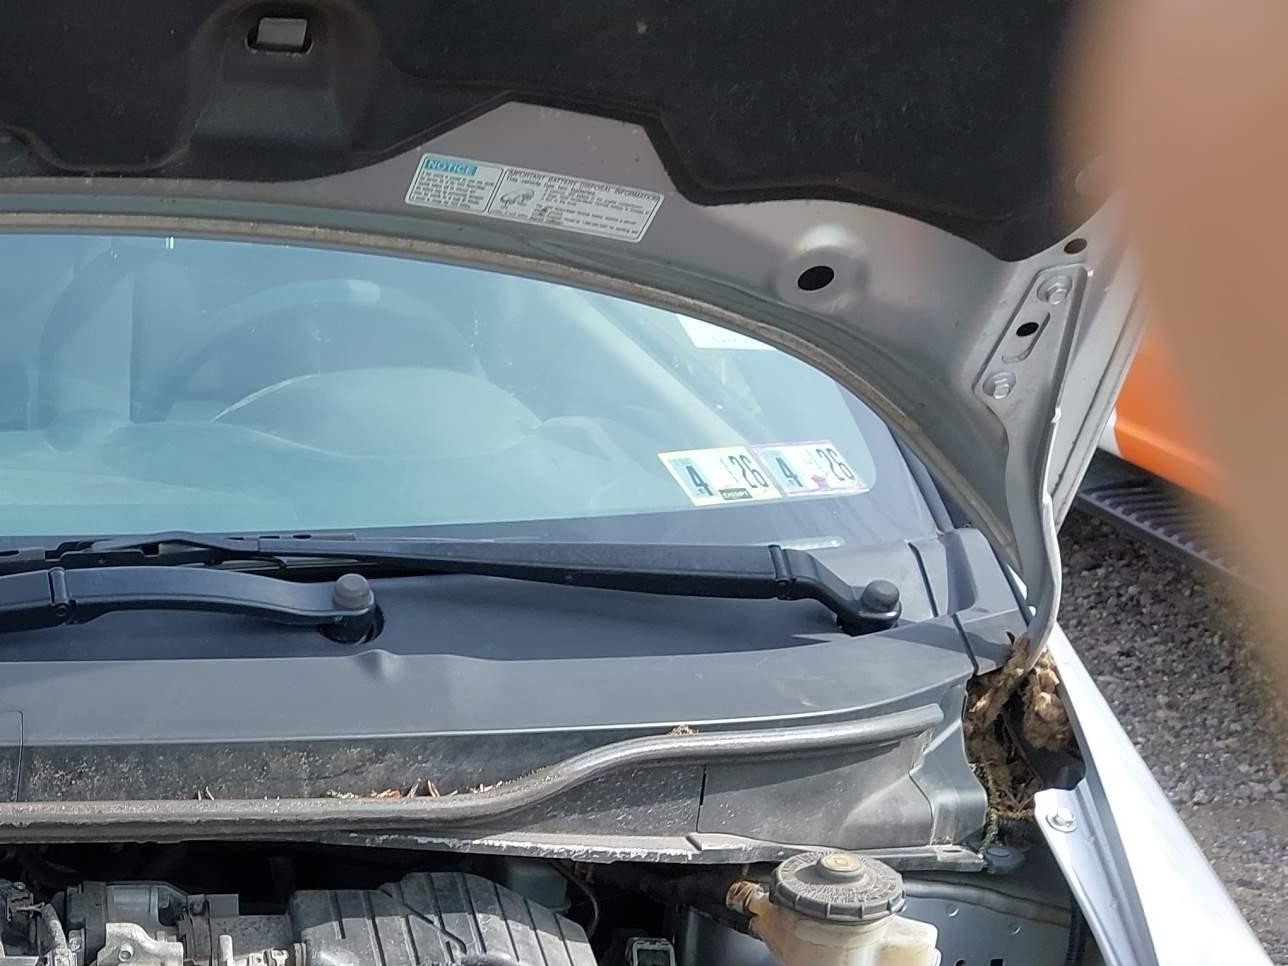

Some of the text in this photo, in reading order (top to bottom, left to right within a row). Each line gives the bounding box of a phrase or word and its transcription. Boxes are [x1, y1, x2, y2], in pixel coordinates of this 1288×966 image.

[427, 159, 475, 175] NOTICE
[508, 169, 661, 201] IMPORTANT BATTERY DISPOSAL INFORMATION
[685, 454, 769, 497] 4 26
[775, 447, 856, 488] 4 26
